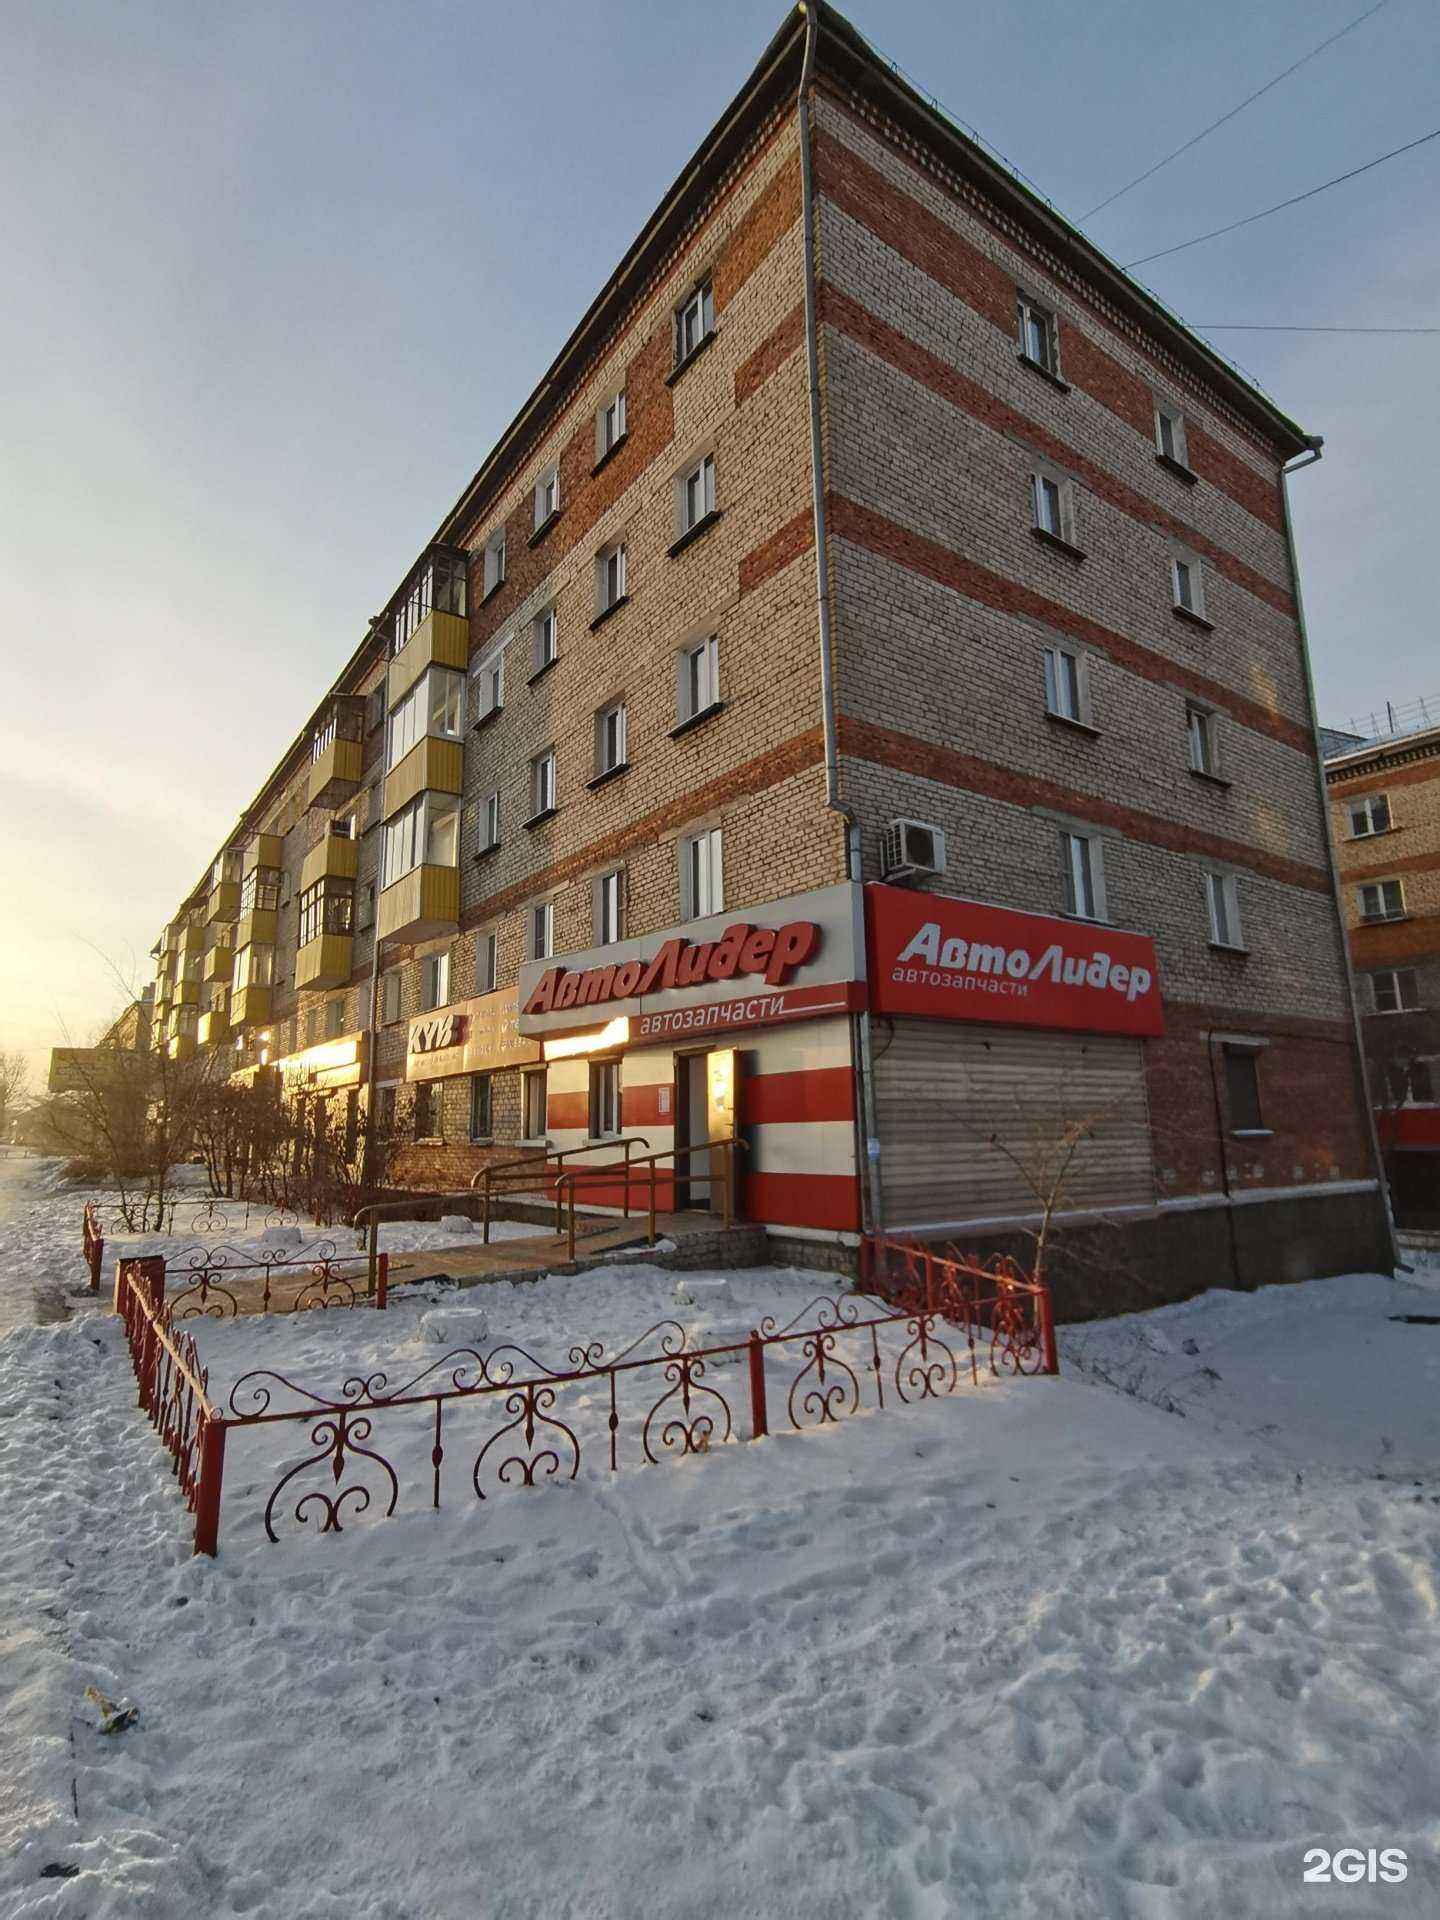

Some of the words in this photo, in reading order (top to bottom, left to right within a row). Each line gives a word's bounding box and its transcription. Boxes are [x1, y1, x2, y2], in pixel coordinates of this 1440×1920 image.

[522, 921, 818, 1013] АвтоЛидер
[891, 967, 1028, 997] автозапчасти
[897, 923, 1151, 1001] АвтоЛидер
[639, 996, 785, 1034] автозапчасти
